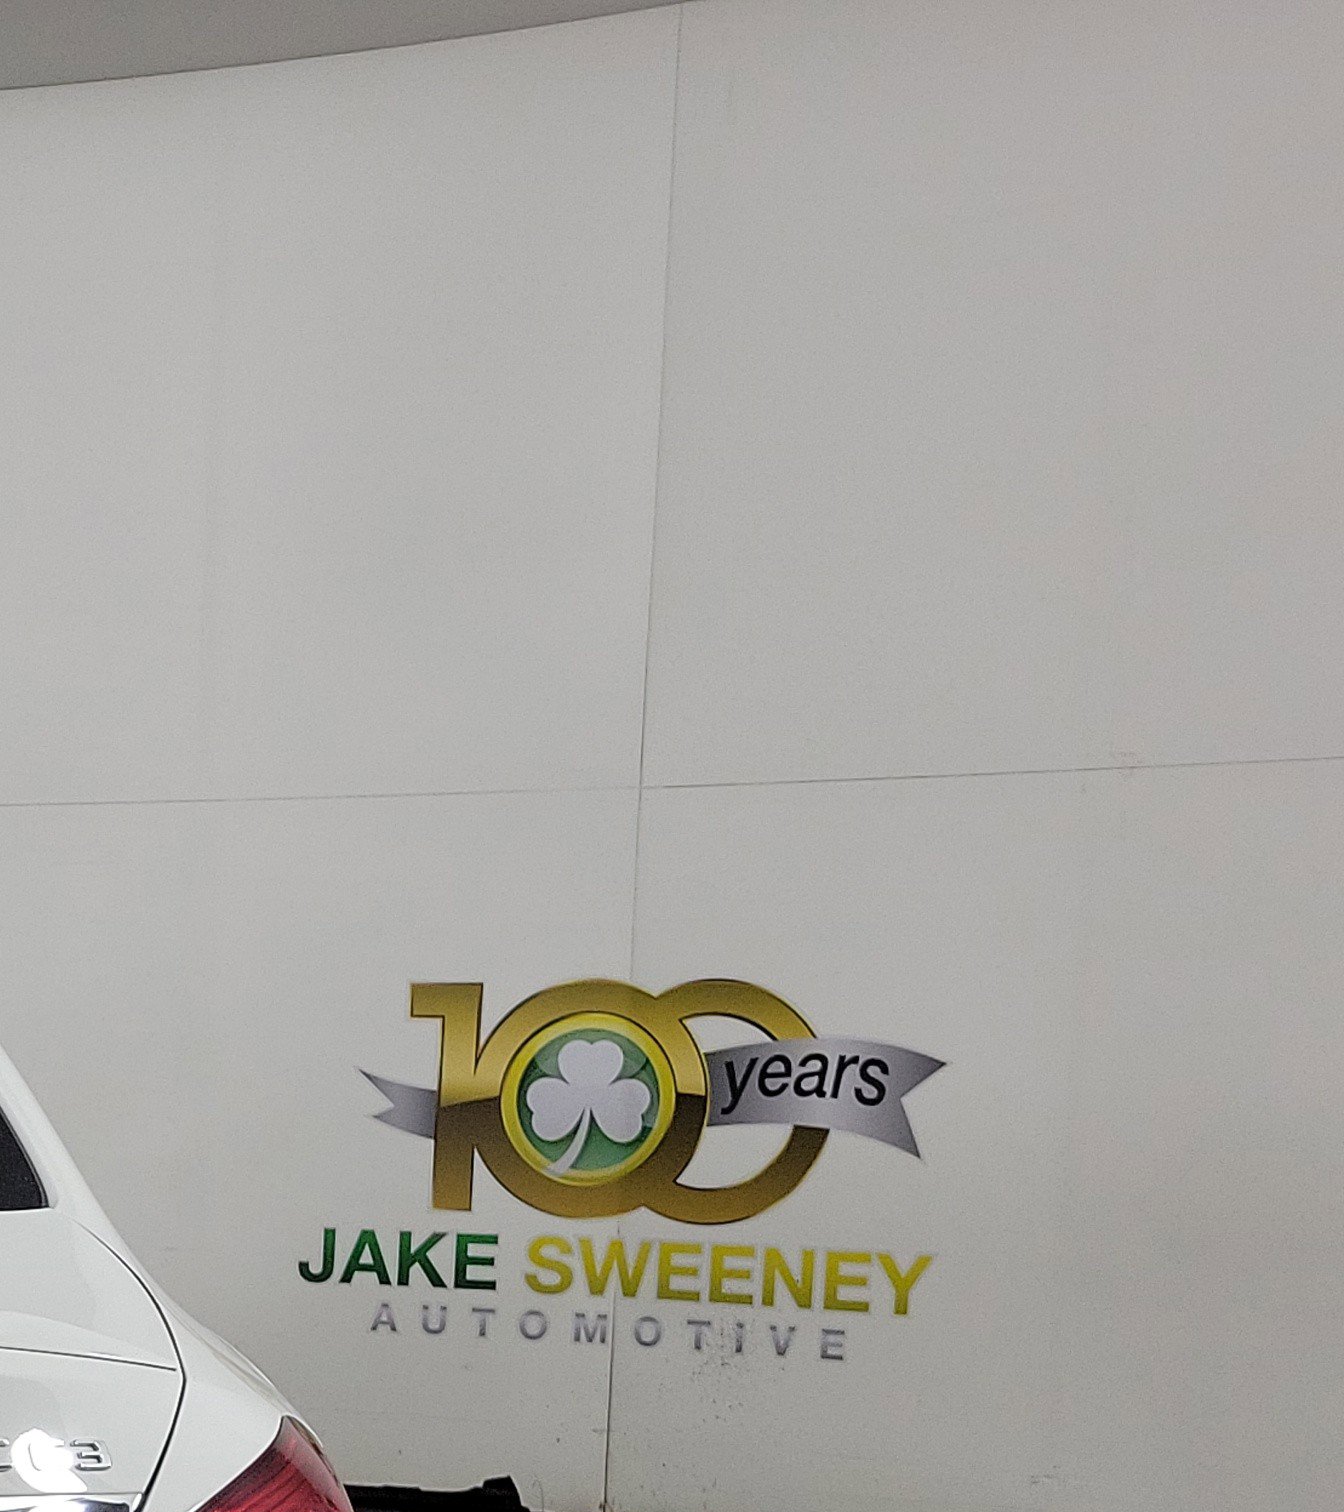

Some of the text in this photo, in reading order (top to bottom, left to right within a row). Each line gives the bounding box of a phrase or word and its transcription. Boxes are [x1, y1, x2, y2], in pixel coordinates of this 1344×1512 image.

[410, 977, 891, 1226] 100 years
[297, 1226, 933, 1316] JAKE SWEENEY
[369, 1303, 847, 1362] AUTOMOTIVE
